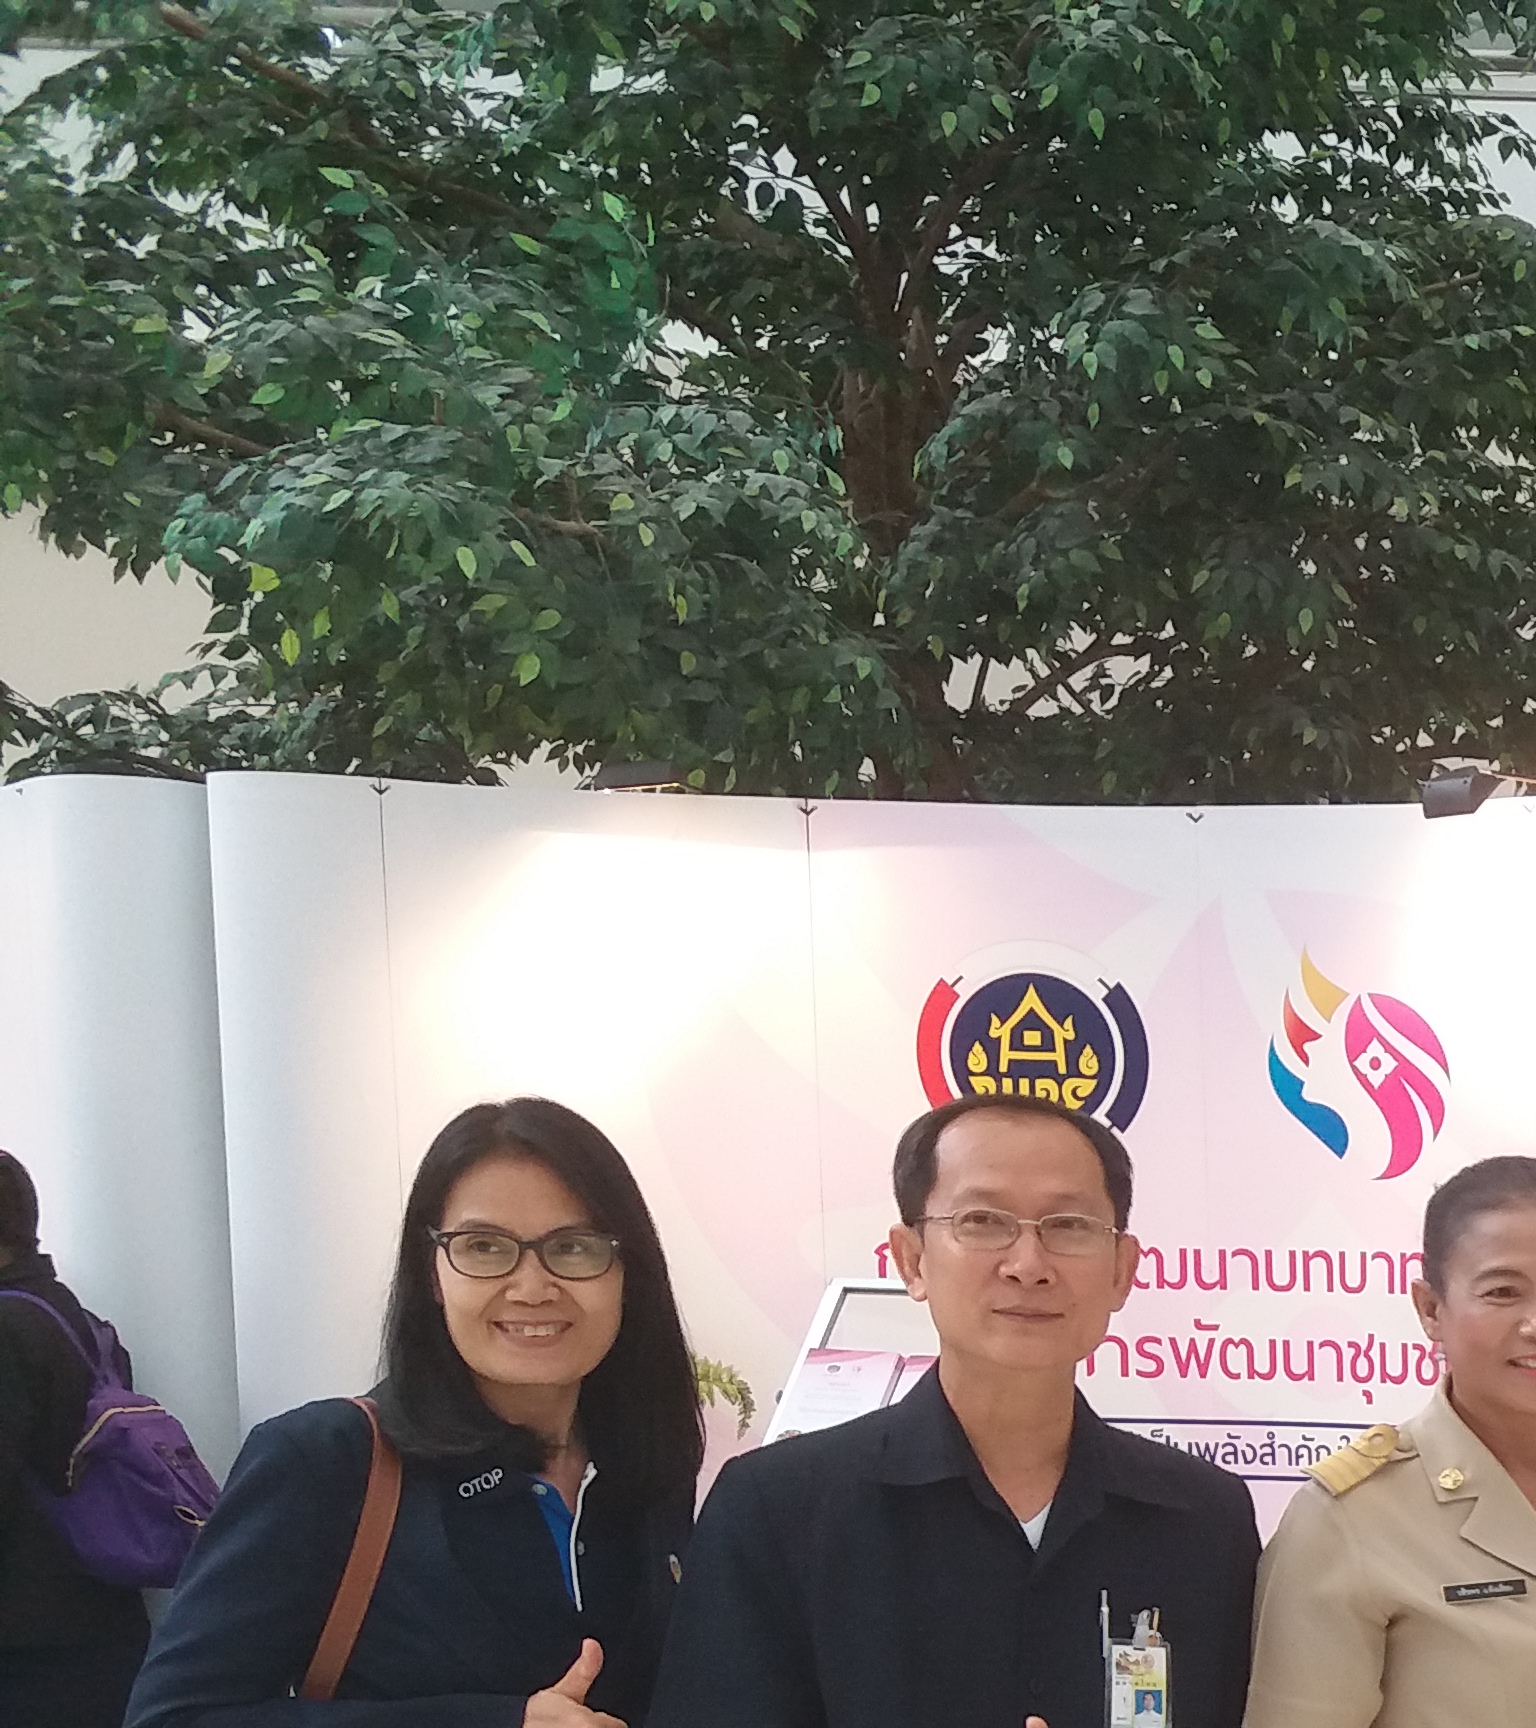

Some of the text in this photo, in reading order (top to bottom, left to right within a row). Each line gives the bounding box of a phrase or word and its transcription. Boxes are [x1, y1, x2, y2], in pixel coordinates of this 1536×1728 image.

[1086, 1318, 1440, 1405] ารพัฒนาชุมช
[458, 1468, 504, 1498] OTOP
